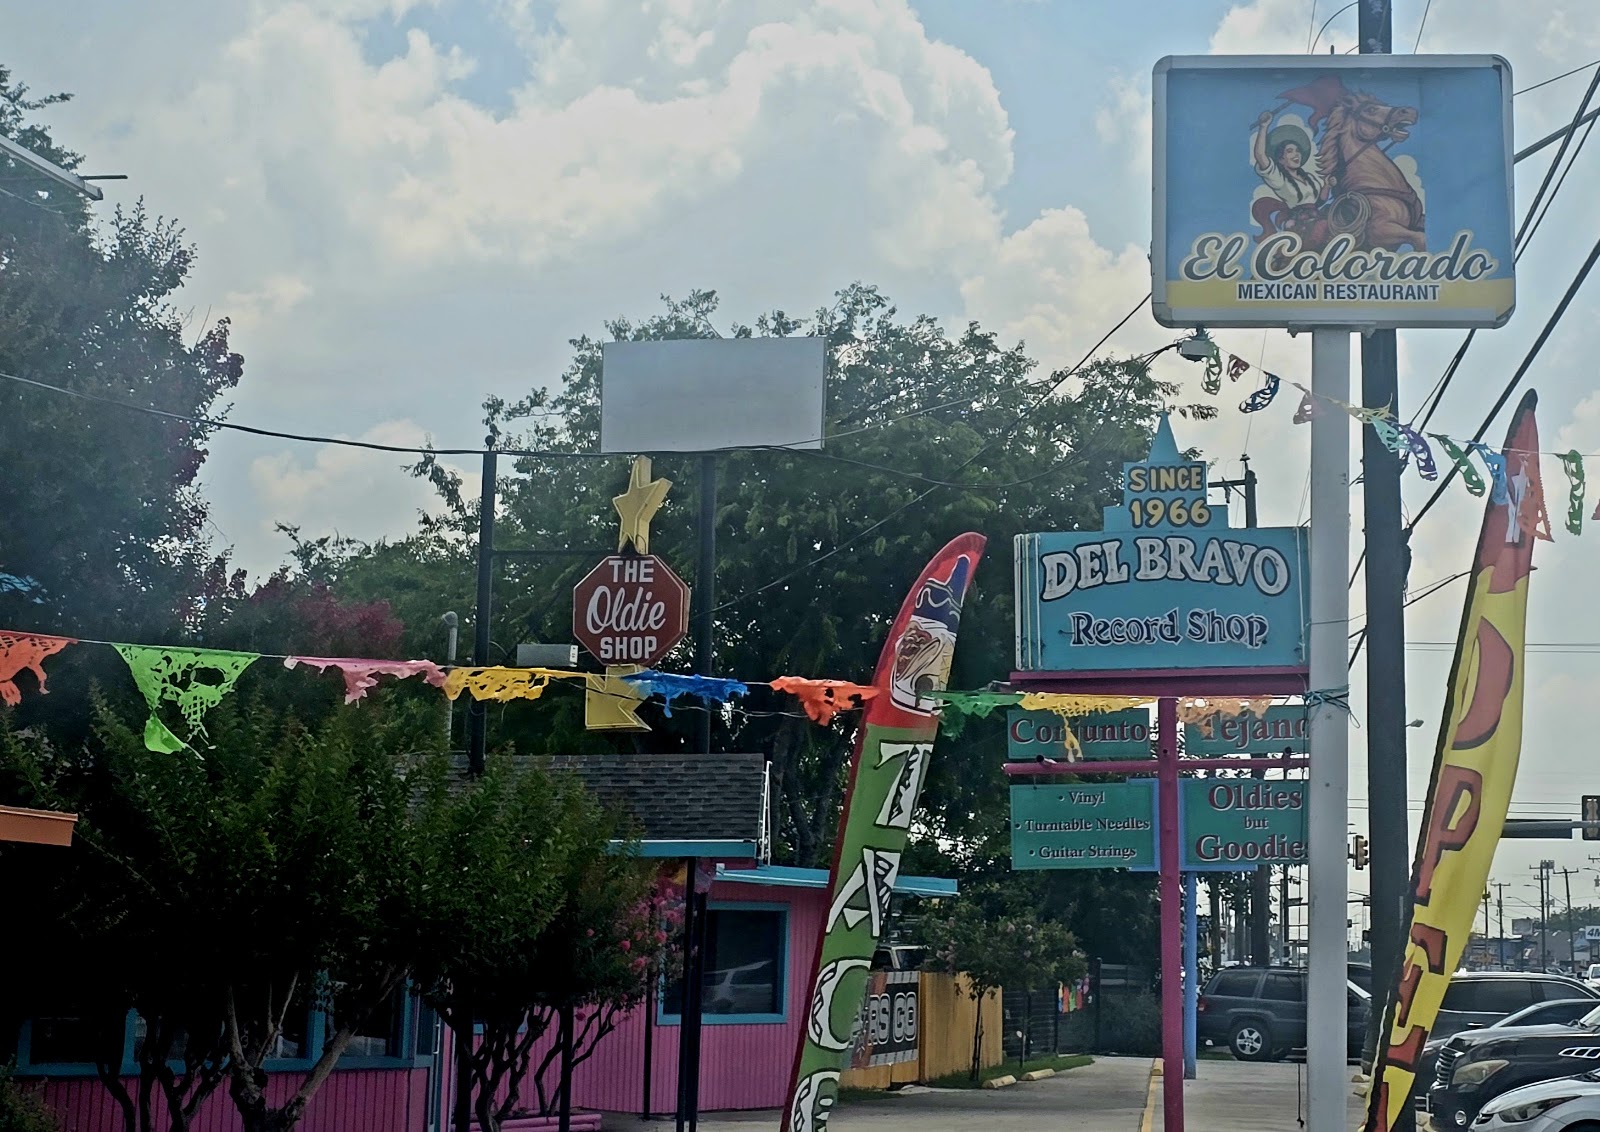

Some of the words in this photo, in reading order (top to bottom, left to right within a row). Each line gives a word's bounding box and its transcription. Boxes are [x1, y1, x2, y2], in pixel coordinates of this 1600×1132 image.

[1182, 234, 1246, 281] El
[1254, 232, 1494, 281] Colorado
[1238, 283, 1317, 300] MEXICAN
[1323, 283, 1440, 300] RESTAURANT
[1128, 465, 1205, 492] SINCE
[1129, 498, 1212, 528] 1966
[608, 559, 654, 583] THE
[1040, 538, 1130, 601] DEL
[1135, 536, 1290, 597] BRAVO
[586, 585, 666, 634] Oldie
[1067, 607, 1182, 646] Record
[1187, 607, 1269, 649] Shop
[600, 636, 657, 660] SHOP
[1010, 718, 1149, 745] Conunto
[1069, 791, 1106, 807] Vinyl
[1208, 783, 1303, 811] Oldies
[1025, 818, 1093, 833] Turntable
[1096, 817, 1151, 831] Needles
[1244, 816, 1269, 830] but
[1039, 846, 1086, 860] Guitar
[1088, 844, 1137, 860] Strings
[1196, 833, 1309, 861] Goodie
